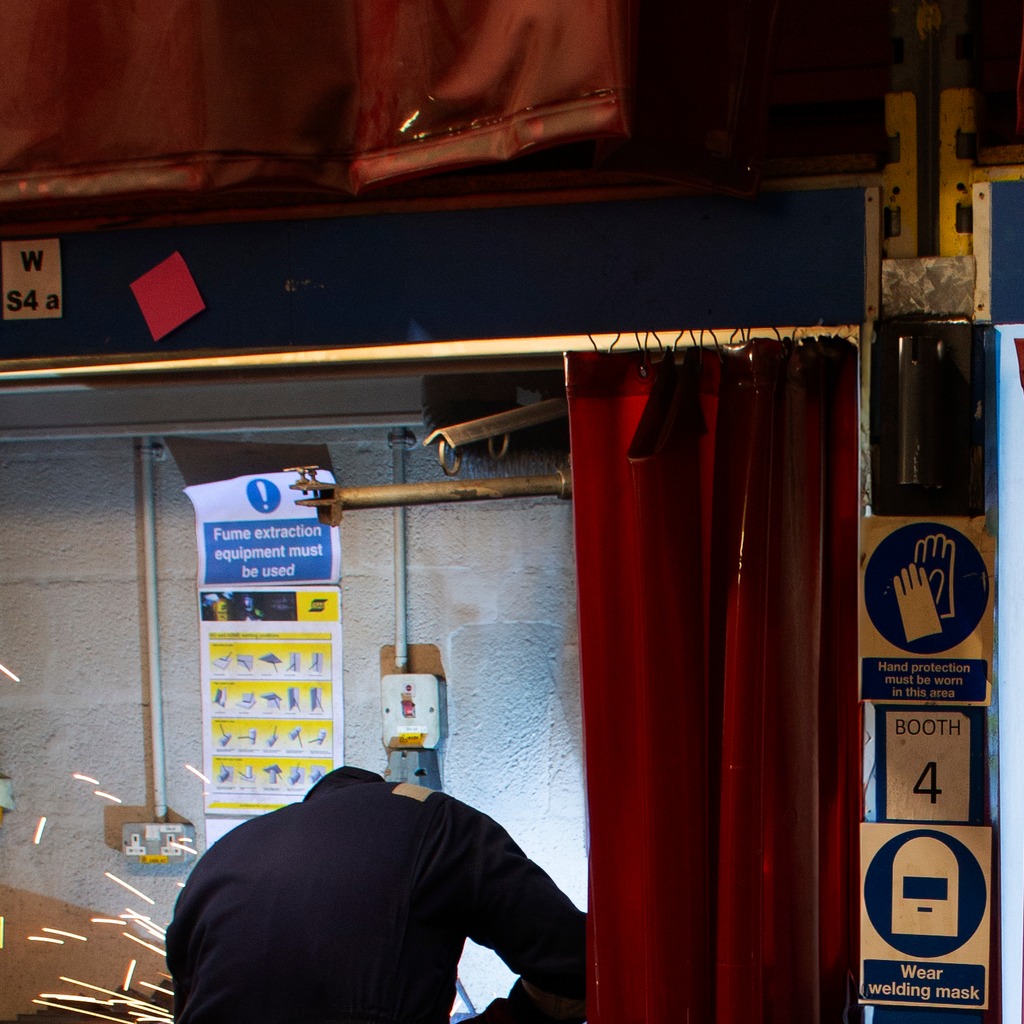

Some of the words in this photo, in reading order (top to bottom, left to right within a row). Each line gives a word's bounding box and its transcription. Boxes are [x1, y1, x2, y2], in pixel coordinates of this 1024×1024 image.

[21, 250, 43, 272] W
[6, 289, 39, 312] S4
[45, 293, 60, 310] a
[213, 527, 251, 541] Fume
[254, 524, 322, 539] extraction
[214, 545, 286, 563] equipment
[289, 543, 323, 557] must
[241, 565, 259, 578] be
[262, 563, 295, 577] used
[878, 661, 908, 672] Hand
[911, 662, 971, 674] protection
[885, 676, 914, 685] must
[916, 675, 931, 685] be
[934, 676, 963, 686] worn
[892, 687, 903, 697] in
[906, 687, 926, 698] this
[930, 689, 955, 698] area
[895, 718, 961, 736] BOOTH
[913, 761, 942, 804] 4
[900, 964, 944, 980] Wear
[868, 981, 931, 1000] welding
[935, 986, 980, 1000] mask
